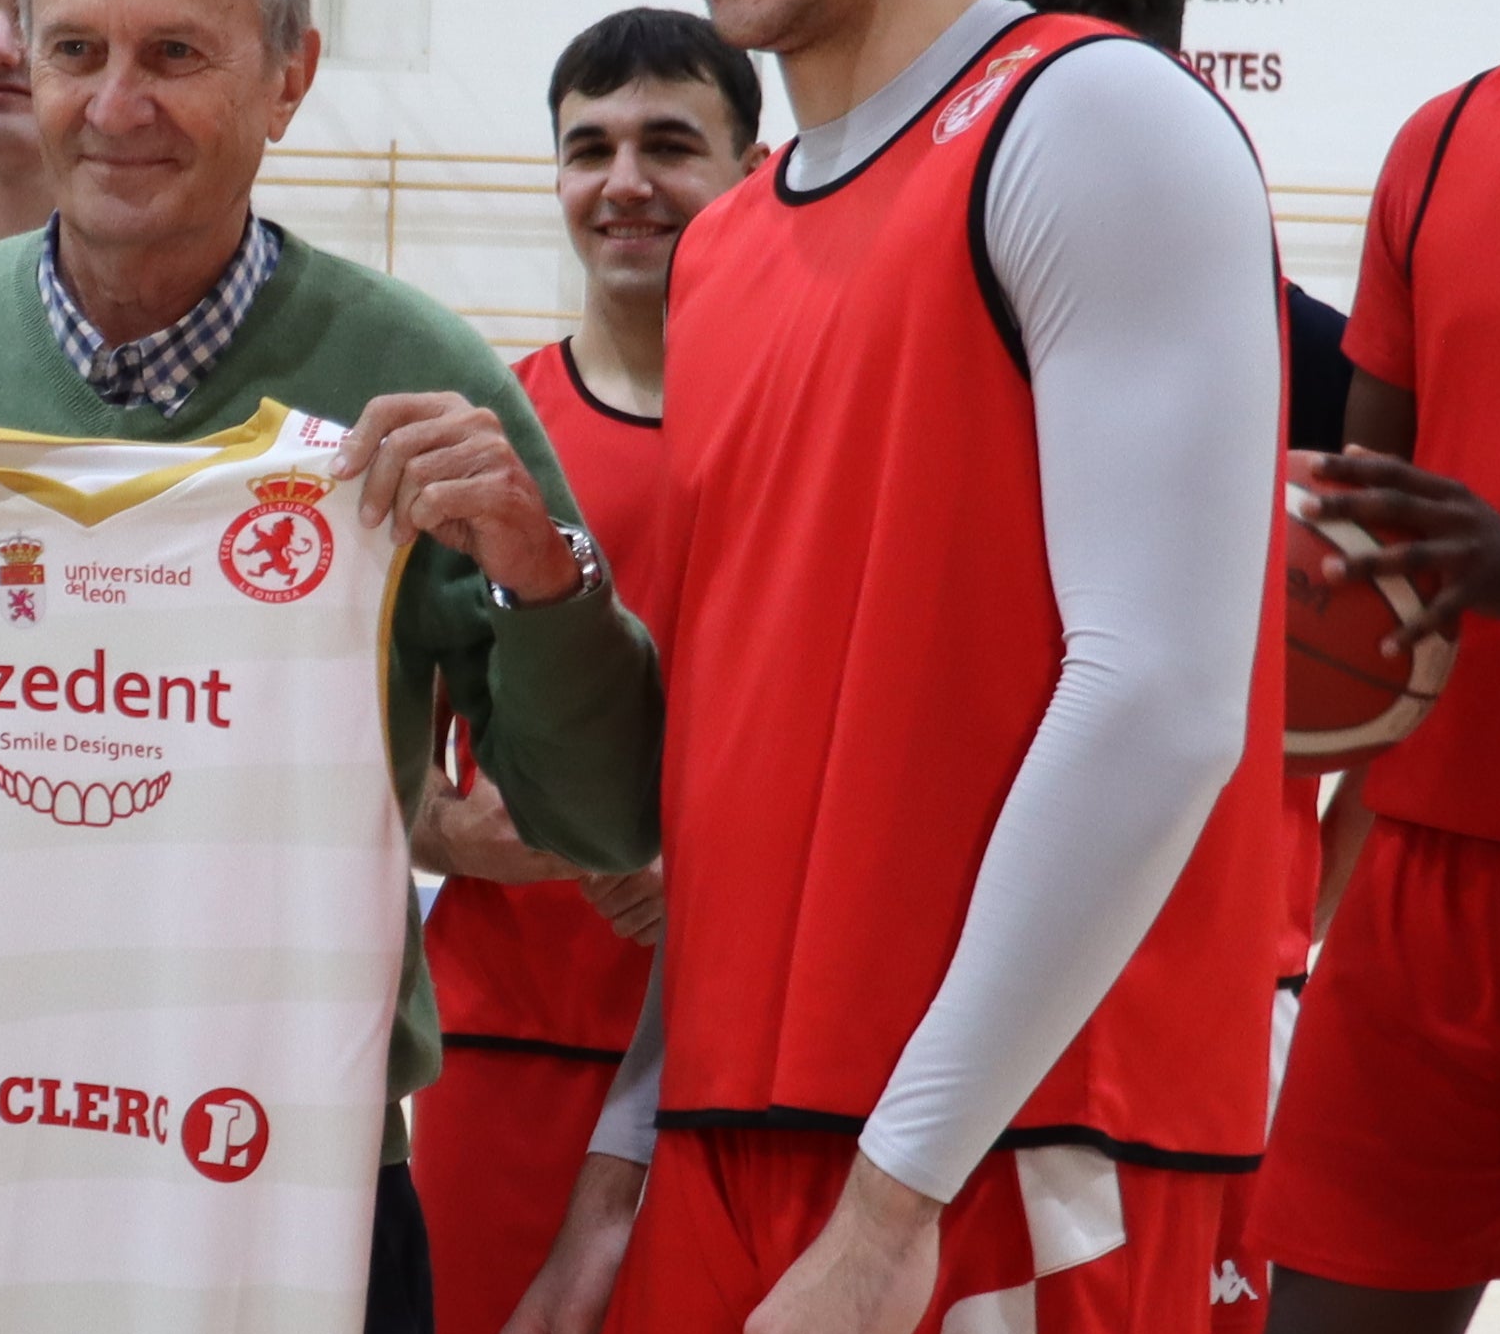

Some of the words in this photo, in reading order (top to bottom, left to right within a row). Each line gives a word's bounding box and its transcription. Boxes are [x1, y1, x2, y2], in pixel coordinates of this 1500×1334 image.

[248, 501, 318, 522] CULTURAL
[318, 540, 332, 573] 1923
[64, 562, 191, 586] universidad
[64, 580, 81, 595] de
[82, 580, 127, 604] león
[238, 581, 300, 602] LEONESA
[0, 732, 58, 752] Smile
[63, 734, 164, 761] Designers
